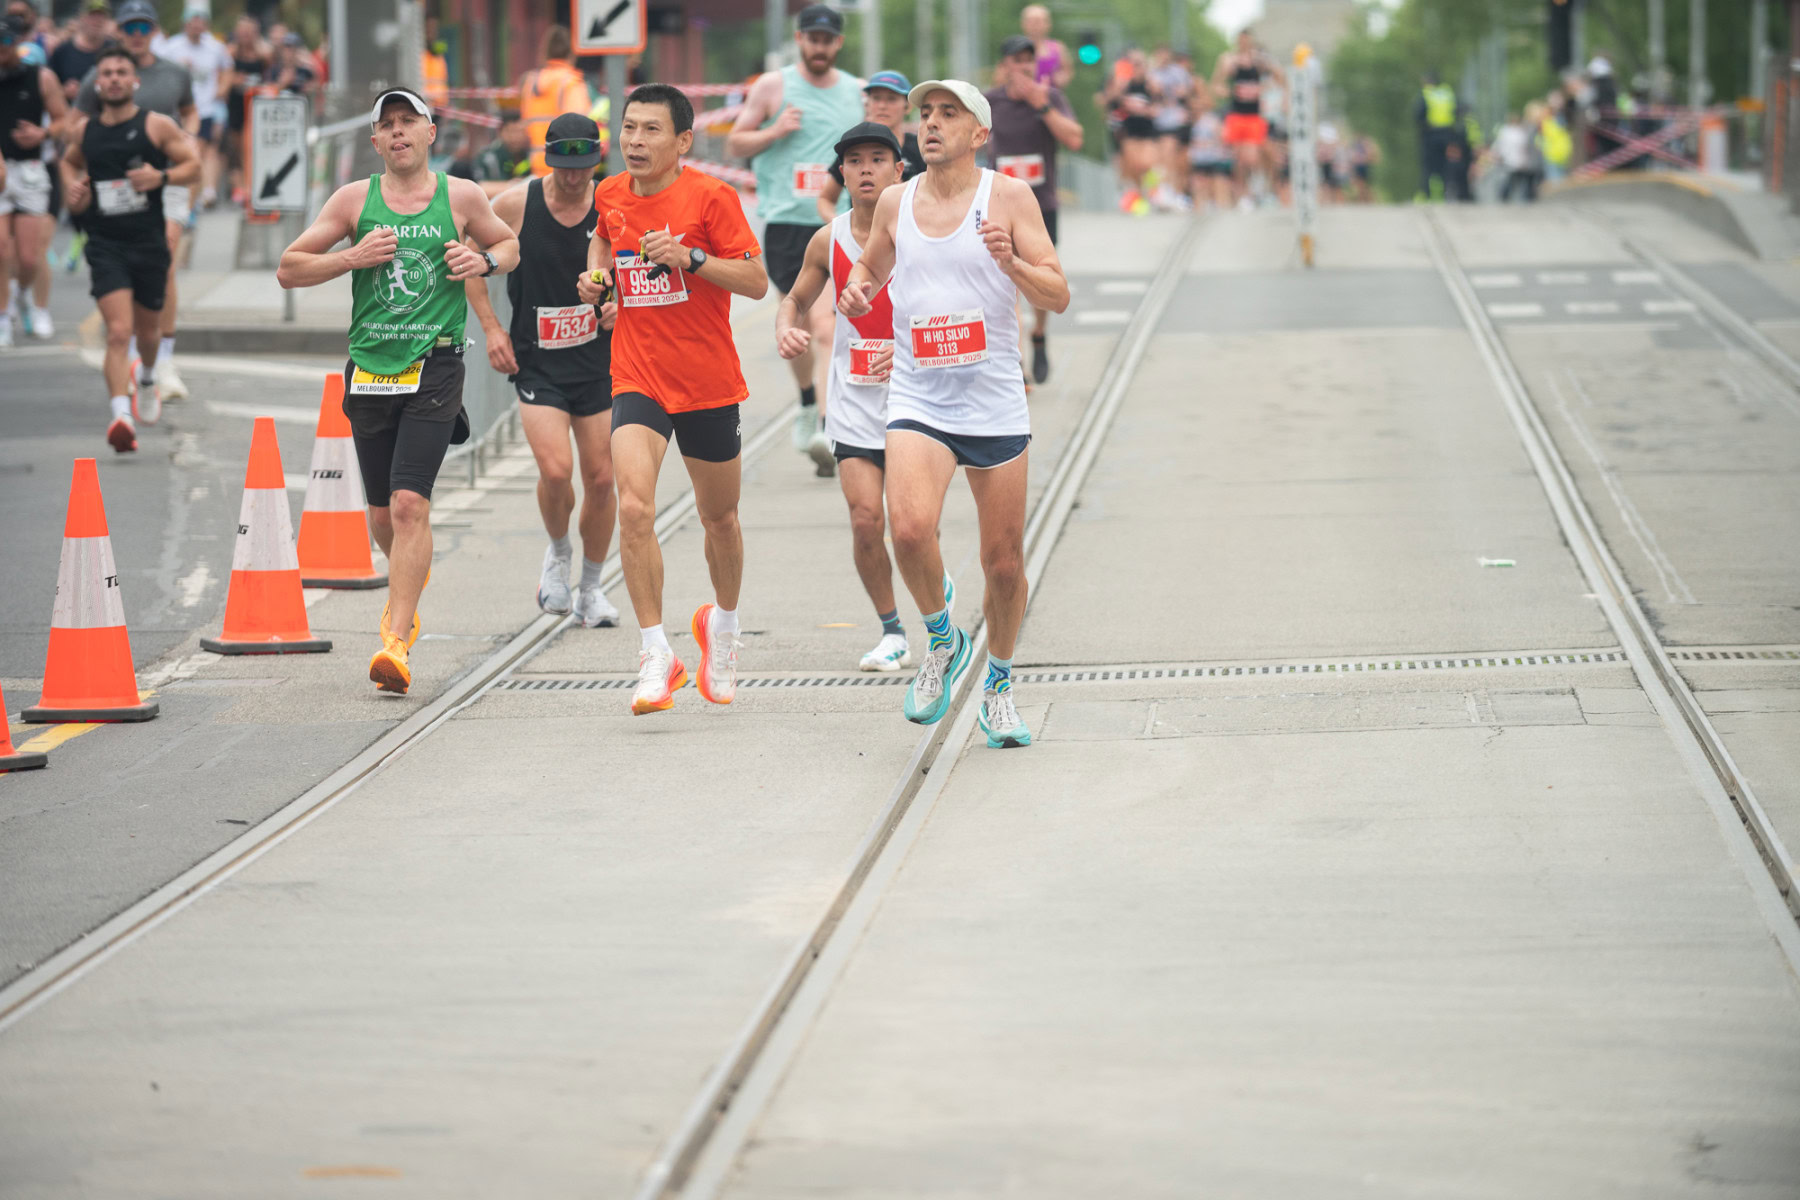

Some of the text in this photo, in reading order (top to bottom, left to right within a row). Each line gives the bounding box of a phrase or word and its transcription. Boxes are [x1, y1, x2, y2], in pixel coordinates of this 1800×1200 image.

[409, 270, 420, 280] 10
[629, 268, 671, 295] 9998
[627, 293, 681, 305] MELBOURNE 2025
[361, 321, 442, 332] MELBOURNE MARATHON
[549, 314, 590, 339] 7534
[369, 331, 430, 341] TEN YEAR RUNNER
[923, 326, 970, 343] HI HO SILVO
[937, 341, 958, 356] 3113
[919, 352, 982, 367] MELBOURNE 2025
[356, 384, 393, 393] MELBOURNE
